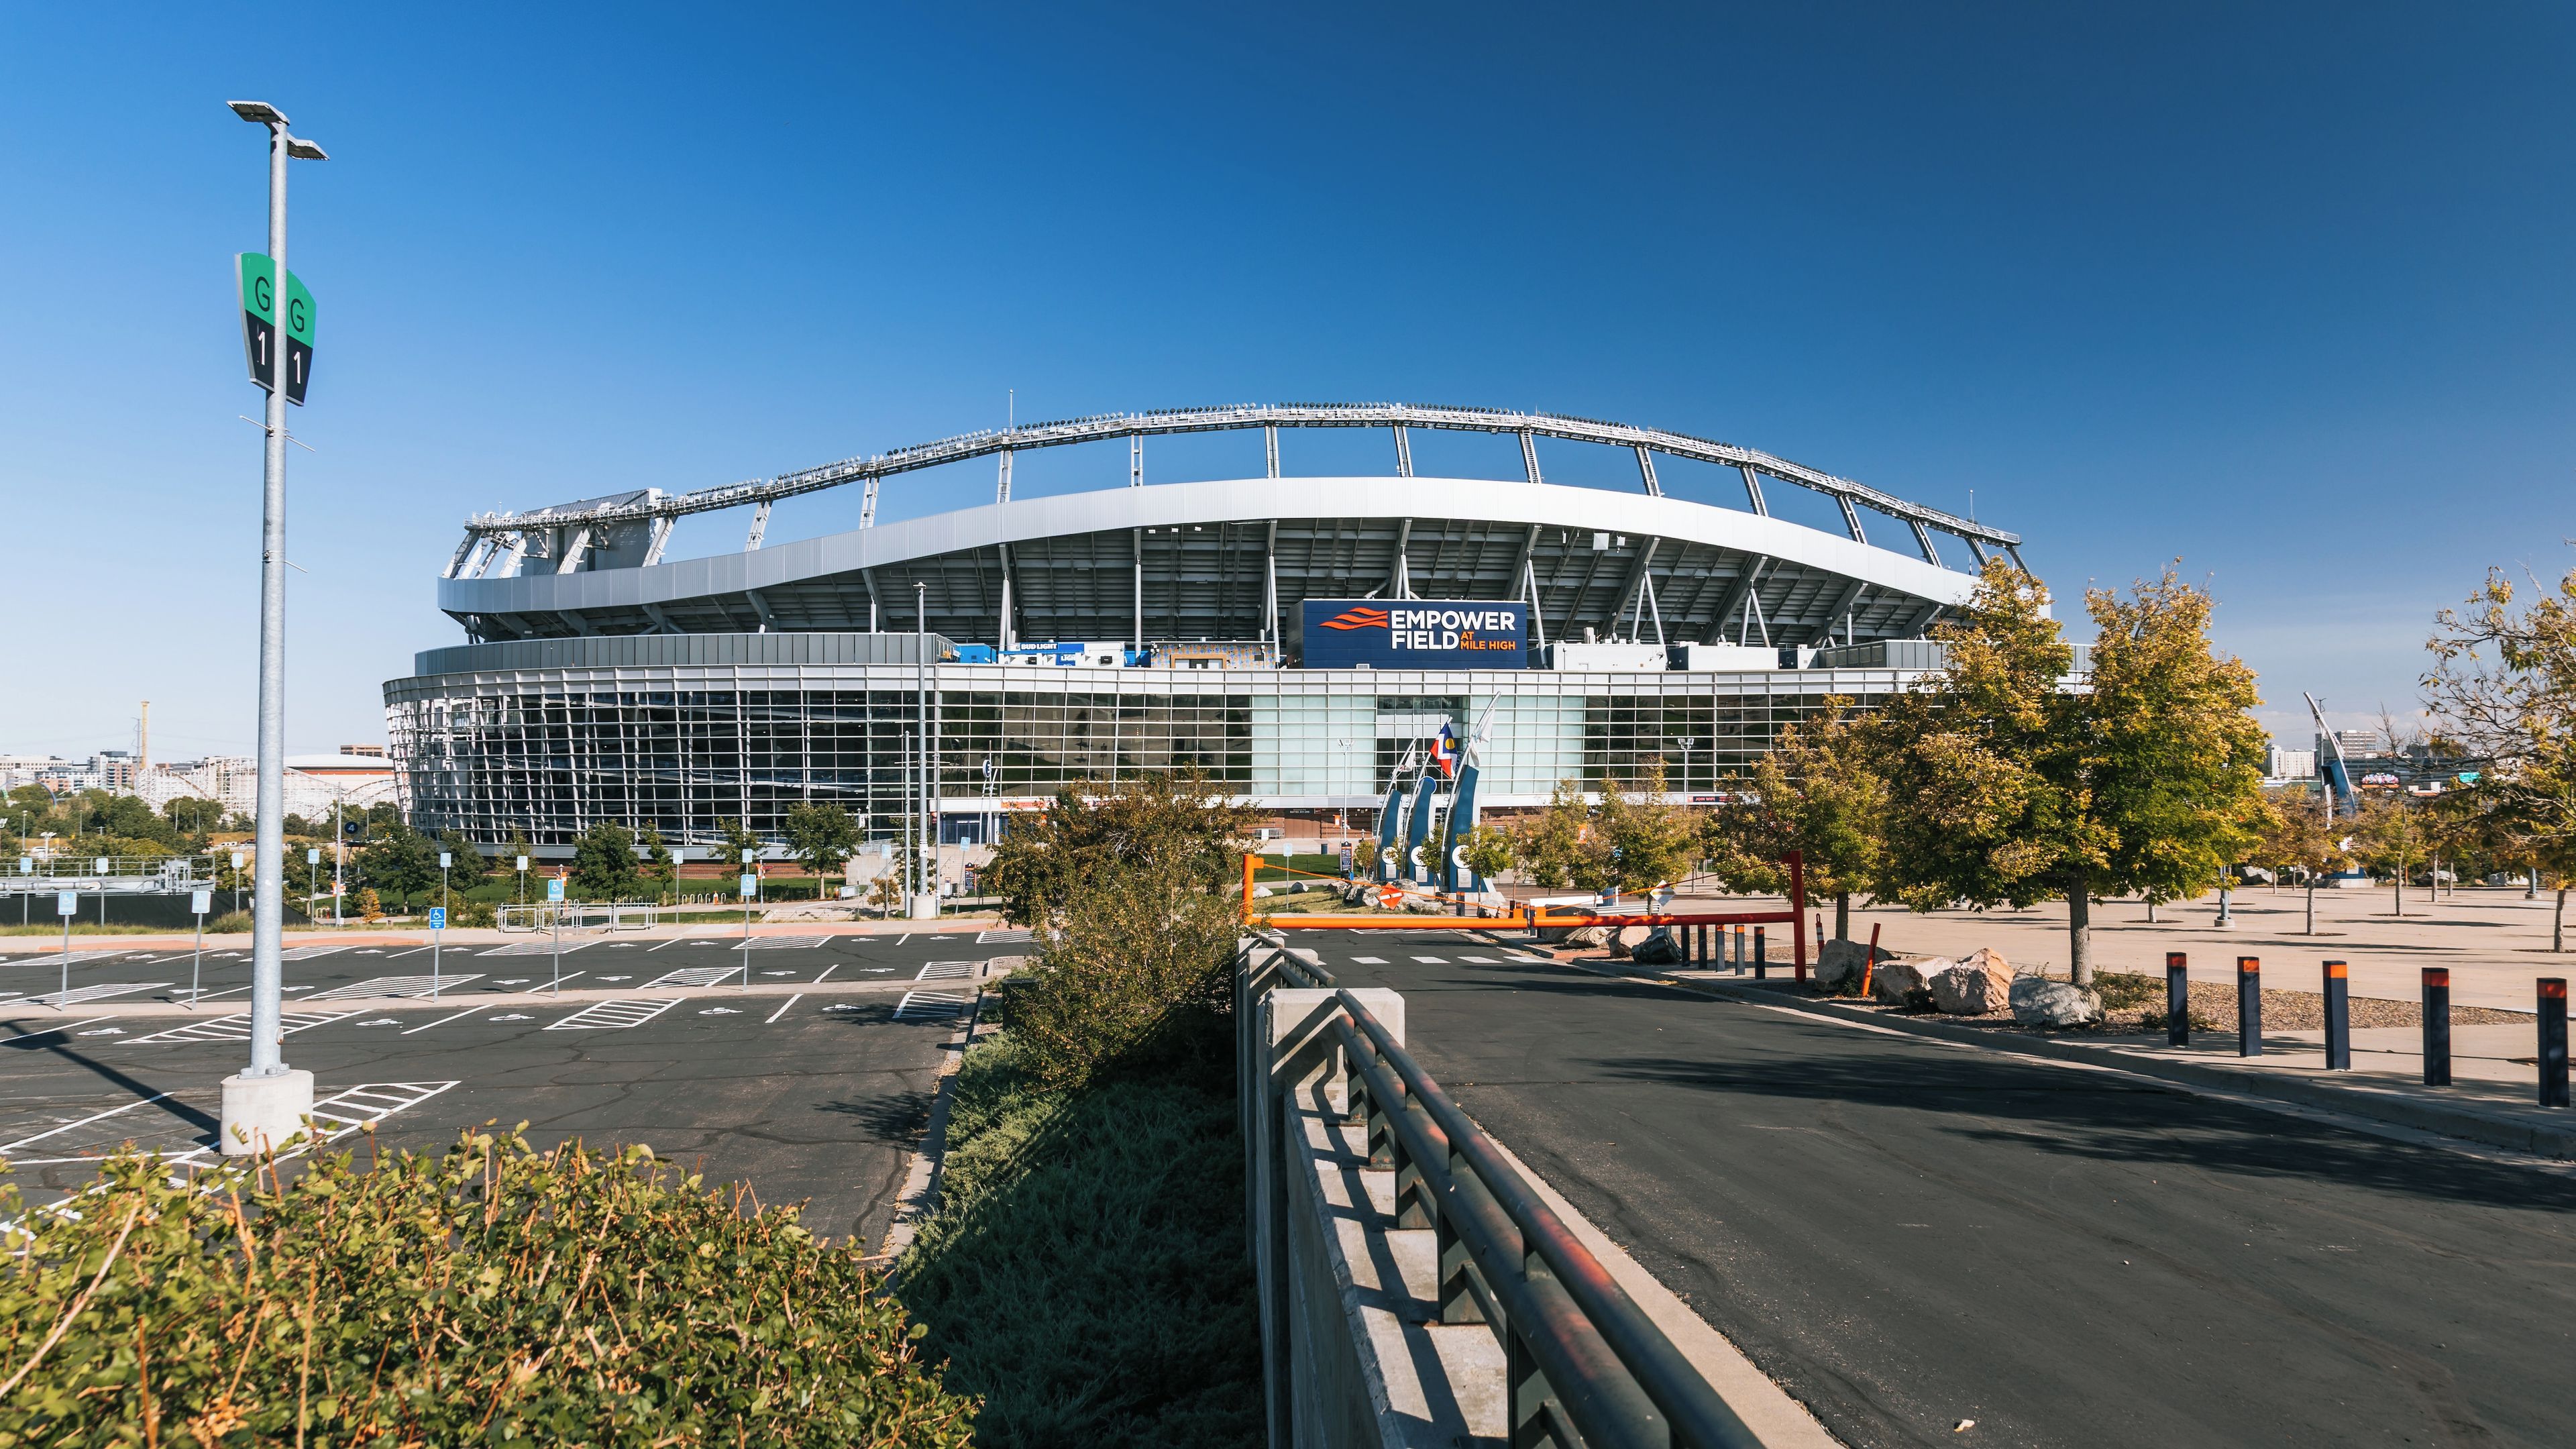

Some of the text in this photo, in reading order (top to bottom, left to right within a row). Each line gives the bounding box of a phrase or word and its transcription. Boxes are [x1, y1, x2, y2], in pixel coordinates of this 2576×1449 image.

[255, 276, 270, 312] G
[290, 299, 305, 333] G
[258, 331, 266, 366] 1
[293, 351, 301, 384] 1
[1391, 610, 1515, 631] EMPOWER
[1391, 631, 1459, 650] FIELD
[1460, 631, 1474, 641] AT
[1460, 641, 1516, 651] MILE HIGH
